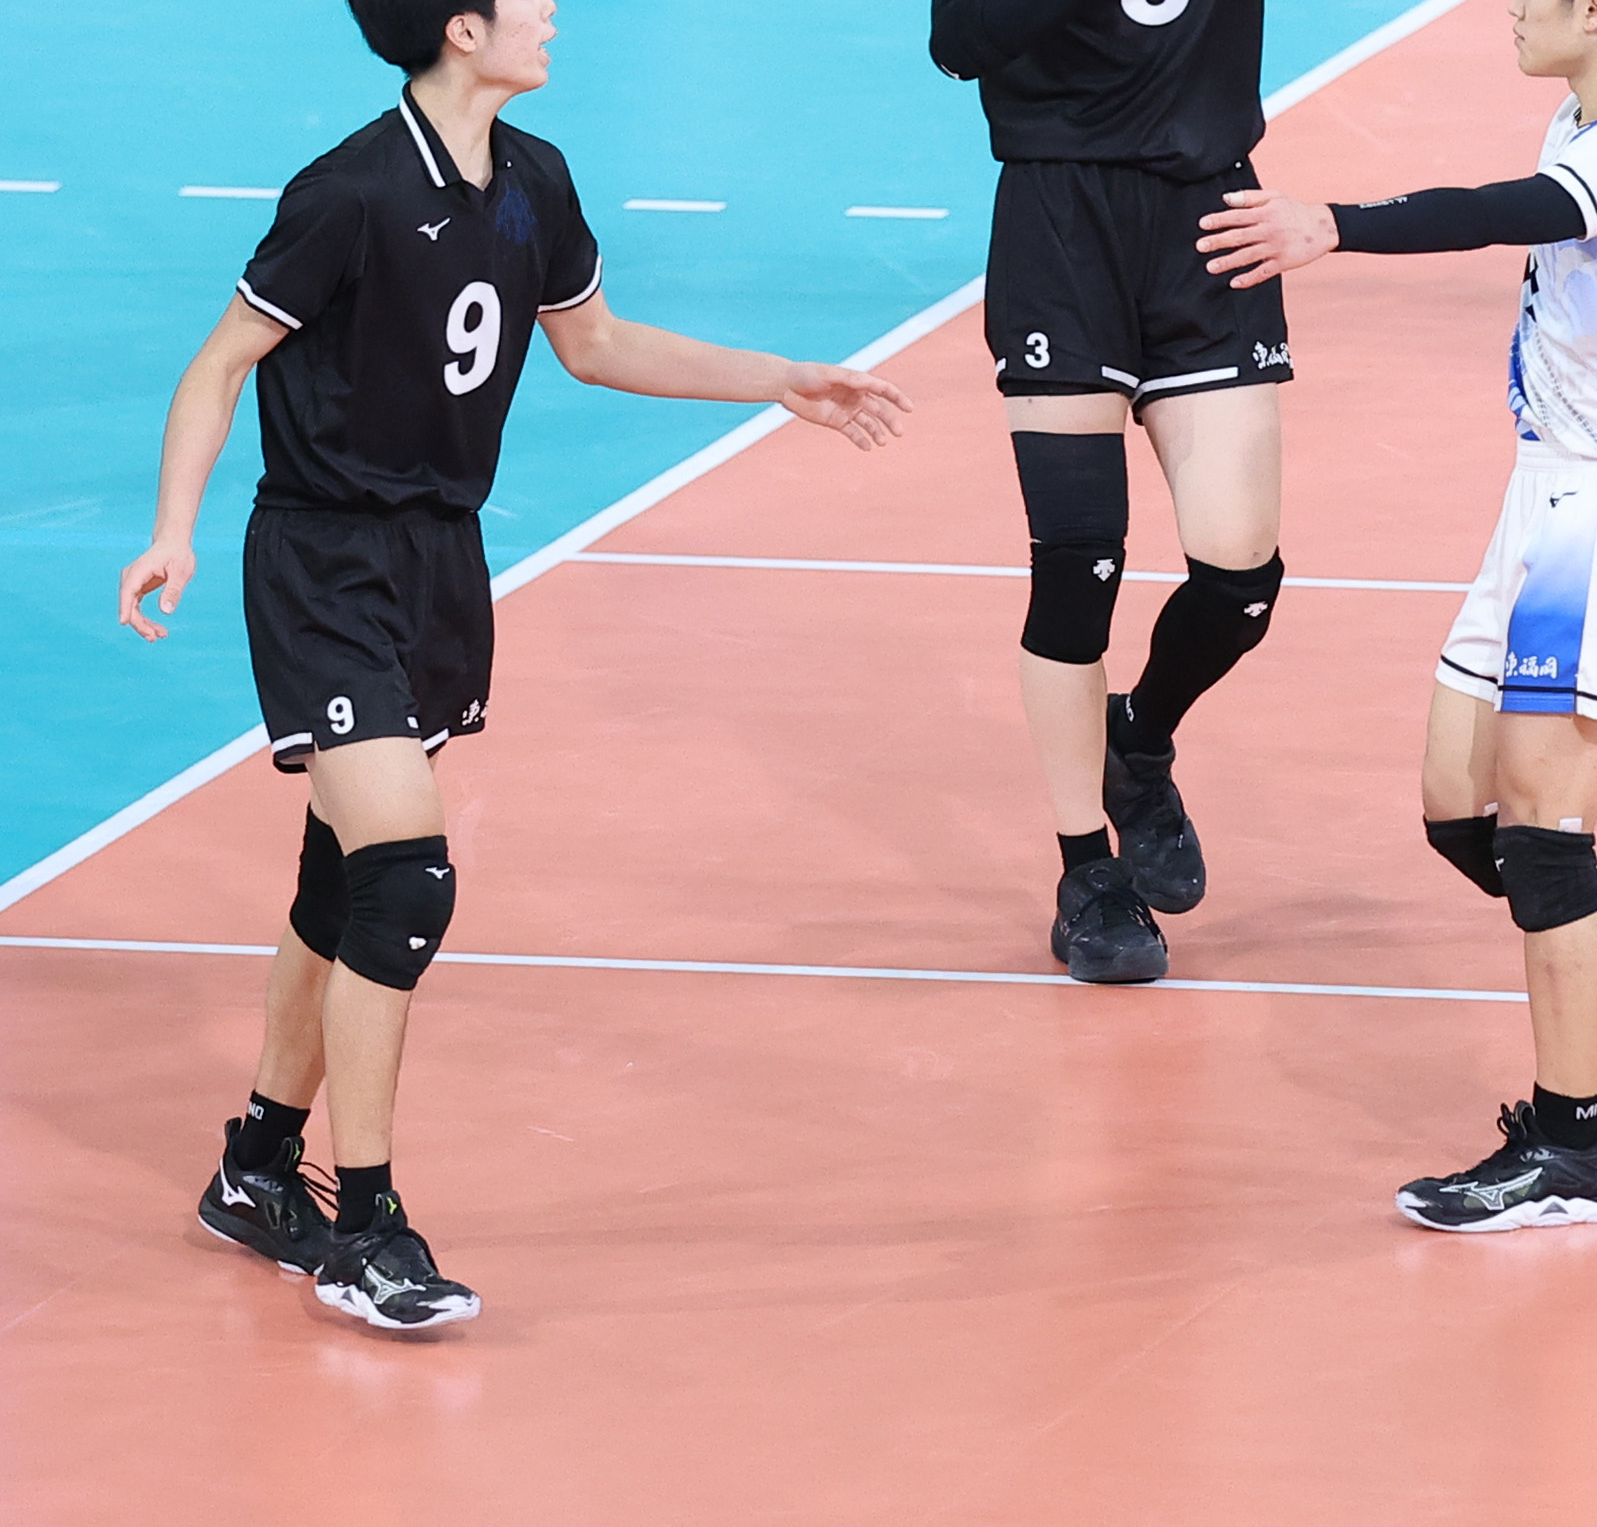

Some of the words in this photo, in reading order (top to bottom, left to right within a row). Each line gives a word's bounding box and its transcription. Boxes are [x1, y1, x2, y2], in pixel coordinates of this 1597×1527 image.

[444, 280, 501, 396] 9
[1024, 332, 1051, 369] 3
[327, 696, 355, 735] 9
